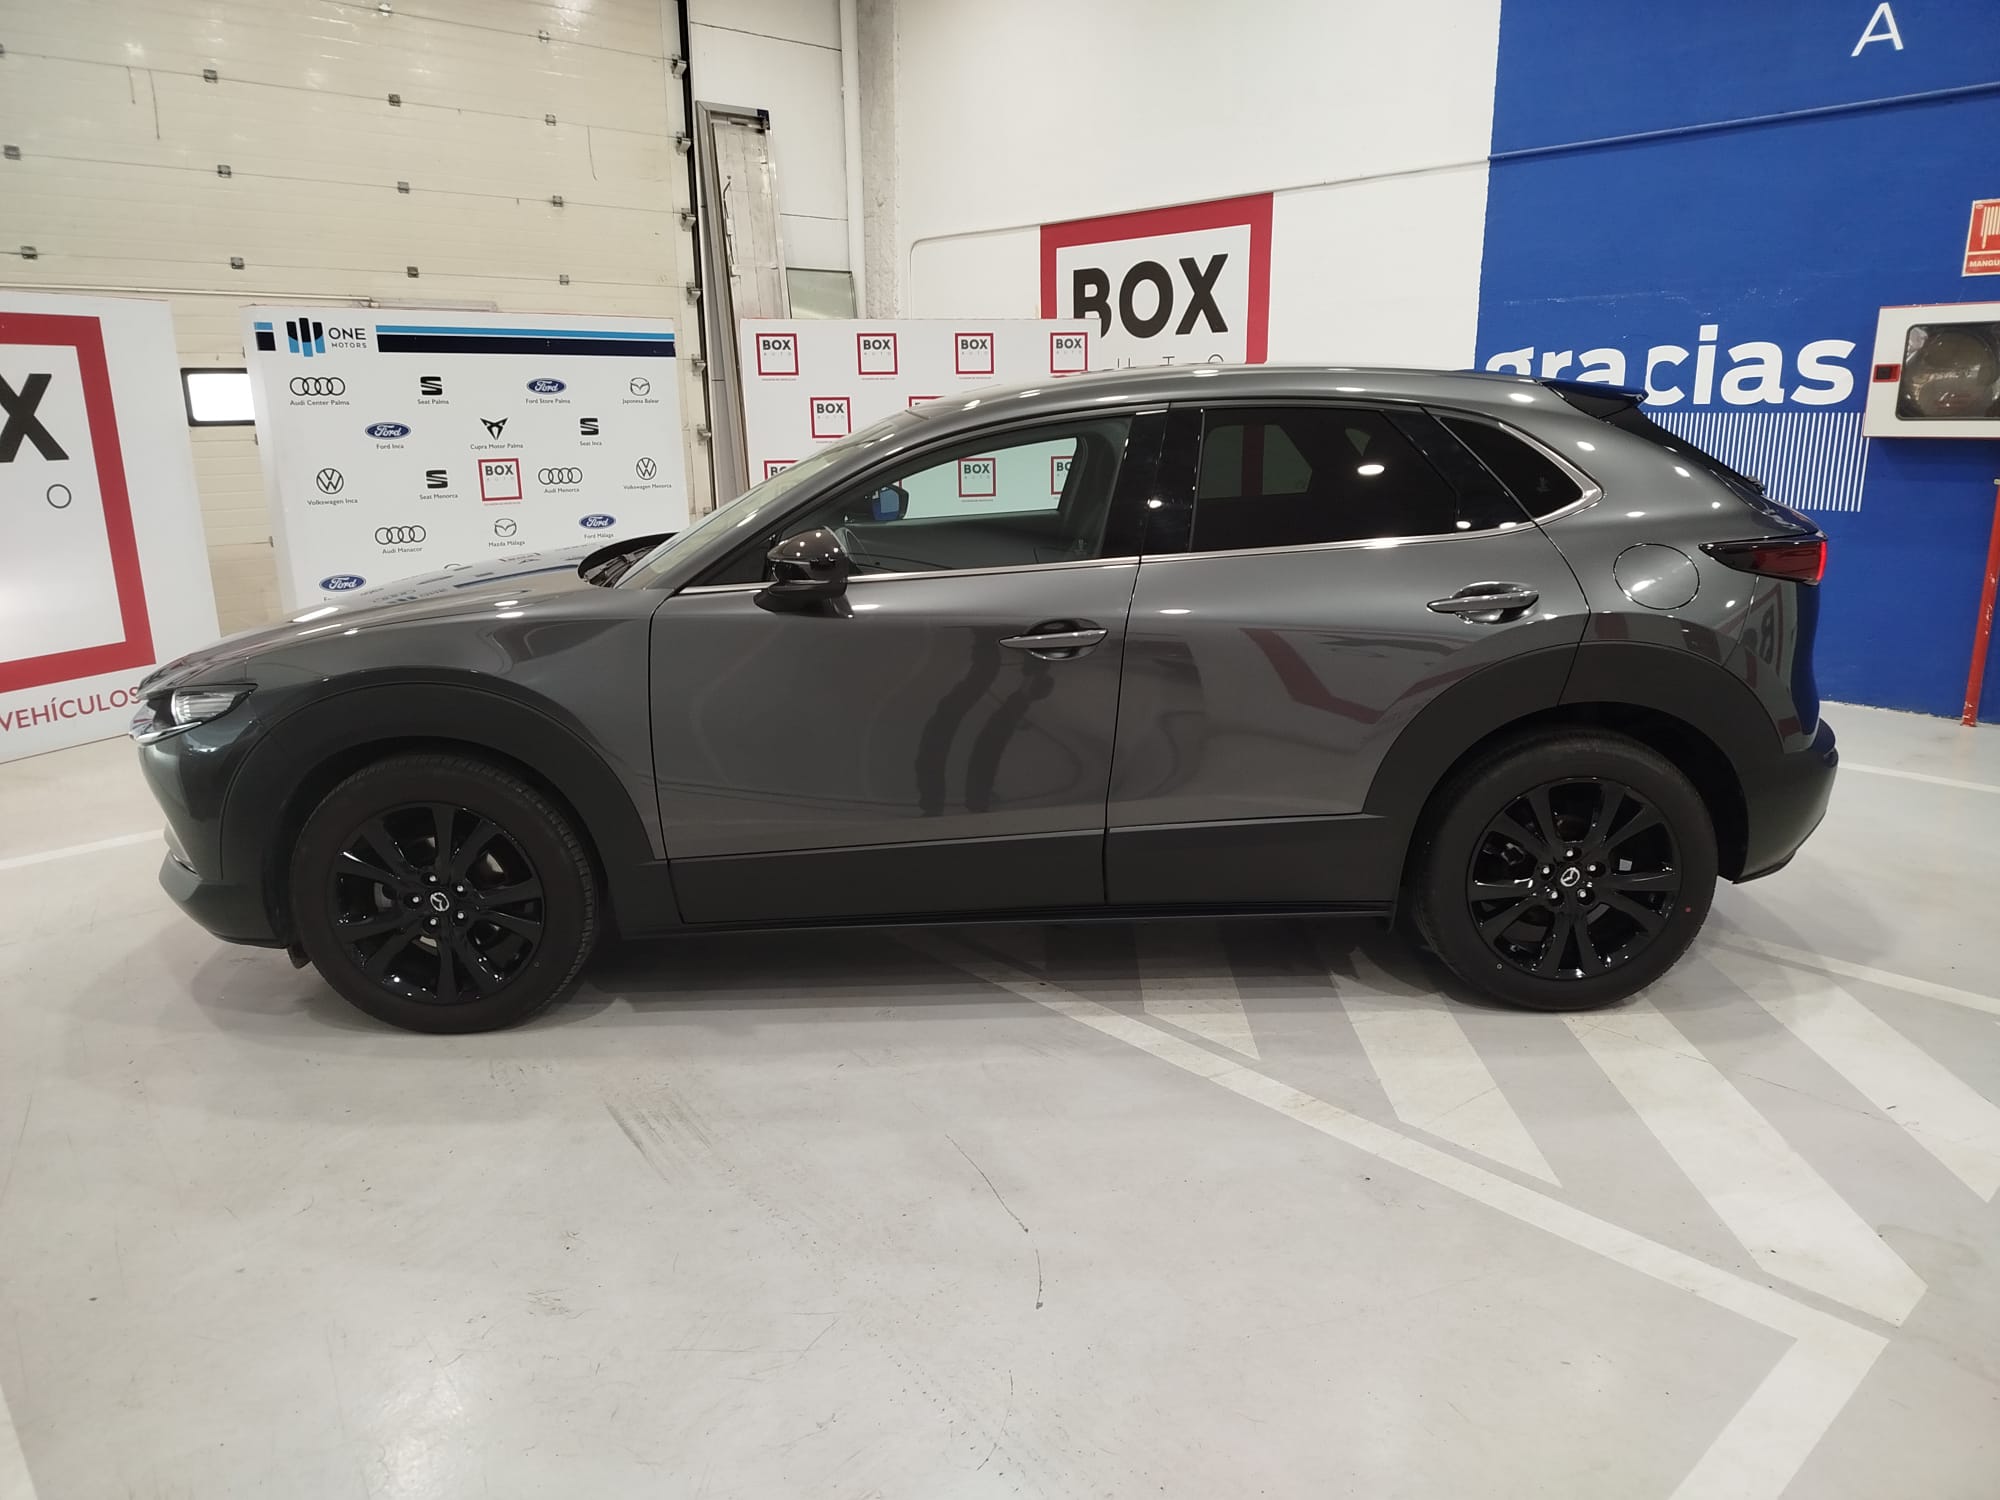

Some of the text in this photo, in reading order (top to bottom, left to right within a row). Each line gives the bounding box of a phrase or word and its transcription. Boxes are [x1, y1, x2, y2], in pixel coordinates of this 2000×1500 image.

[1073, 253, 1229, 339] BOX
[328, 327, 367, 340] ONE
[762, 340, 791, 350] BOX
[863, 339, 891, 350] BOX
[961, 339, 988, 350] BOX
[1056, 338, 1082, 349] BOX
[534, 381, 558, 391] Ford
[816, 403, 845, 414] BOX
[374, 424, 402, 437] Ford
[485, 464, 514, 476] BOX
[964, 463, 990, 474] BOX
[587, 516, 609, 526] Ford
[329, 577, 357, 589] Ford
